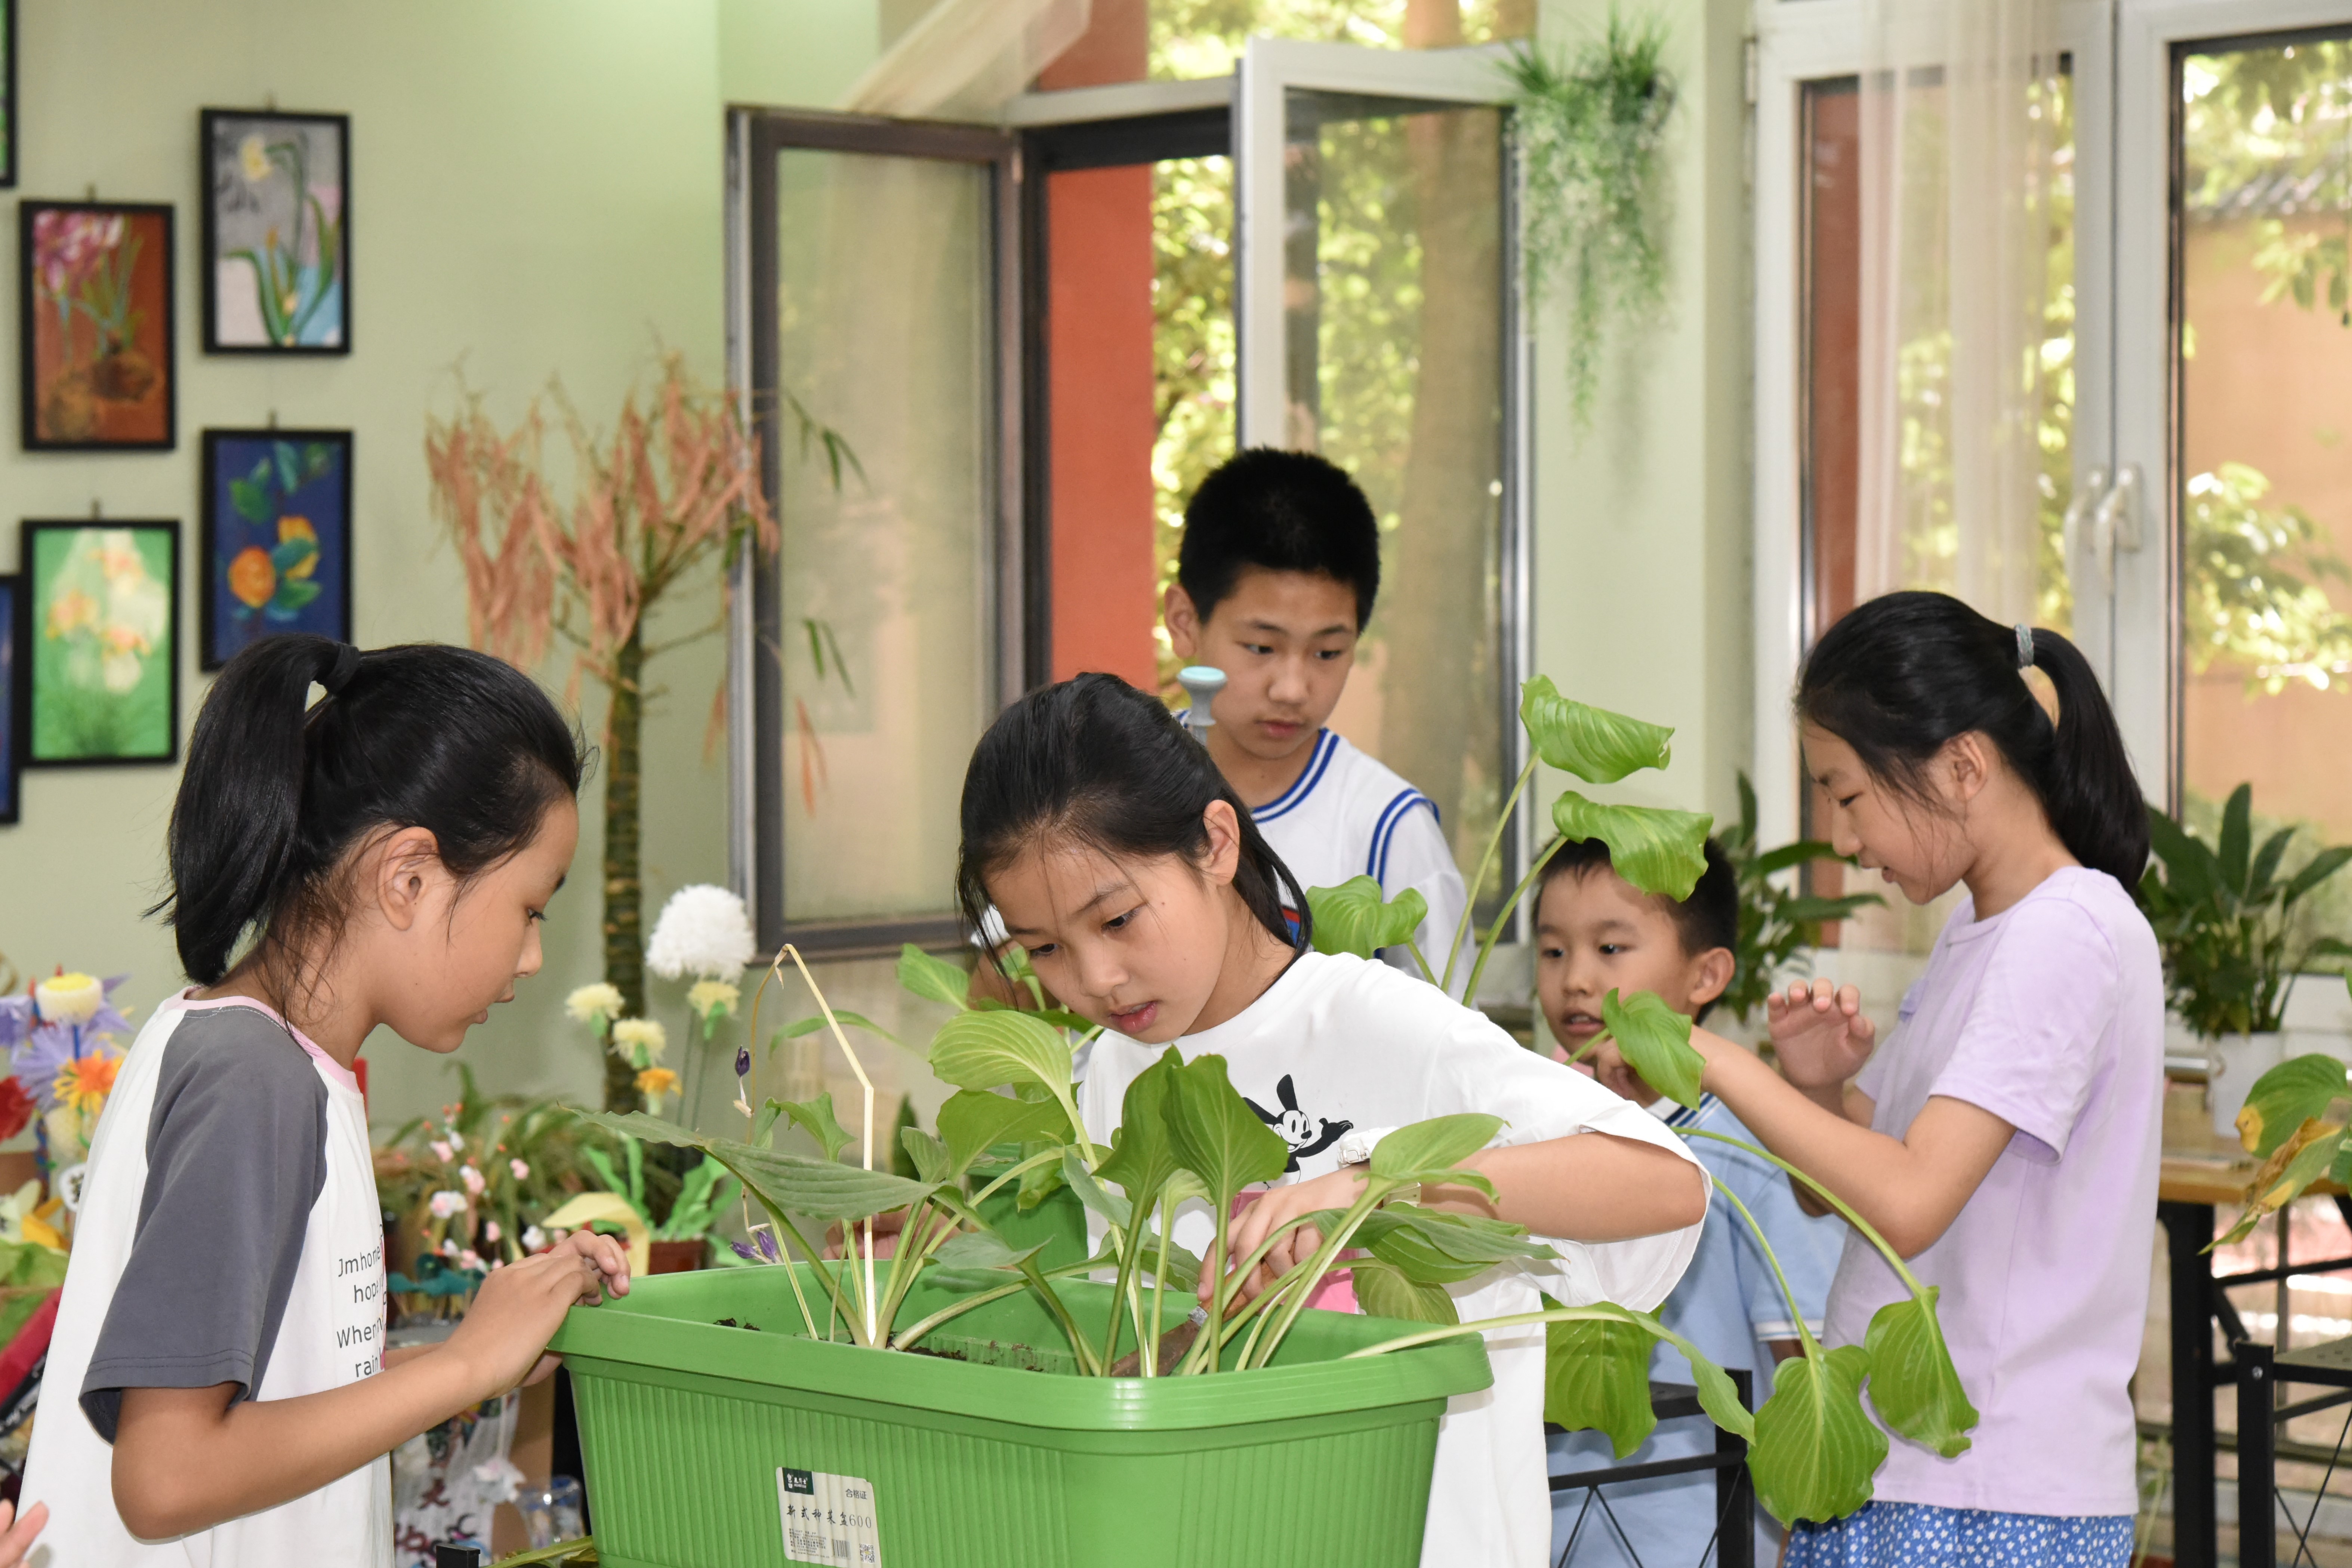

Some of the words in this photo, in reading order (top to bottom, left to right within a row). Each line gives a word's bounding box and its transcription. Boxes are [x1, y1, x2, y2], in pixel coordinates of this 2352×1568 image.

[354, 1280, 379, 1303] hope
[845, 1488, 867, 1500] 合格证
